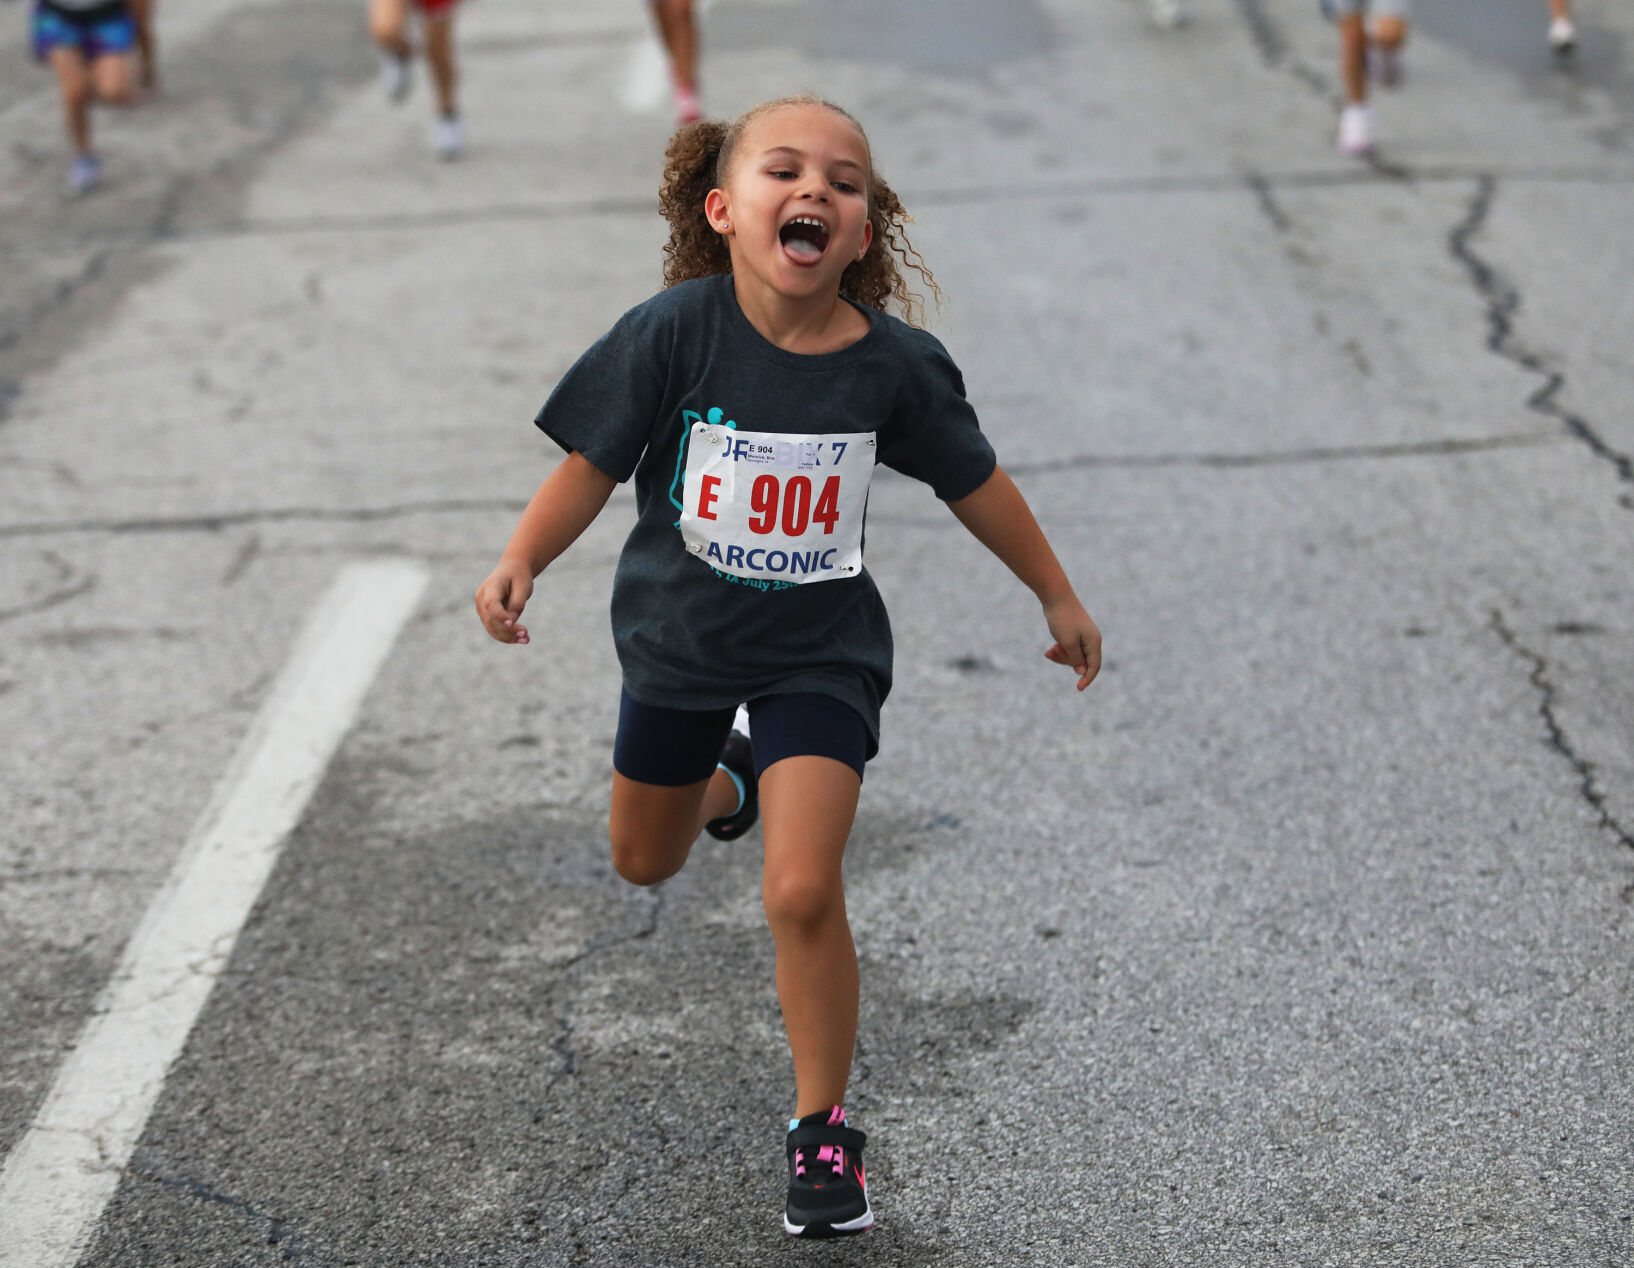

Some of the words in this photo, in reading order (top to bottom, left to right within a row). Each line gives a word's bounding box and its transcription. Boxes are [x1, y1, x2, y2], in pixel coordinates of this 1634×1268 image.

[749, 444, 756, 452] E
[757, 445, 773, 454] 904
[832, 442, 848, 466] 7
[697, 474, 722, 521] E
[748, 474, 841, 537] 904
[706, 541, 838, 574] ARCONIC
[742, 577, 771, 592] July
